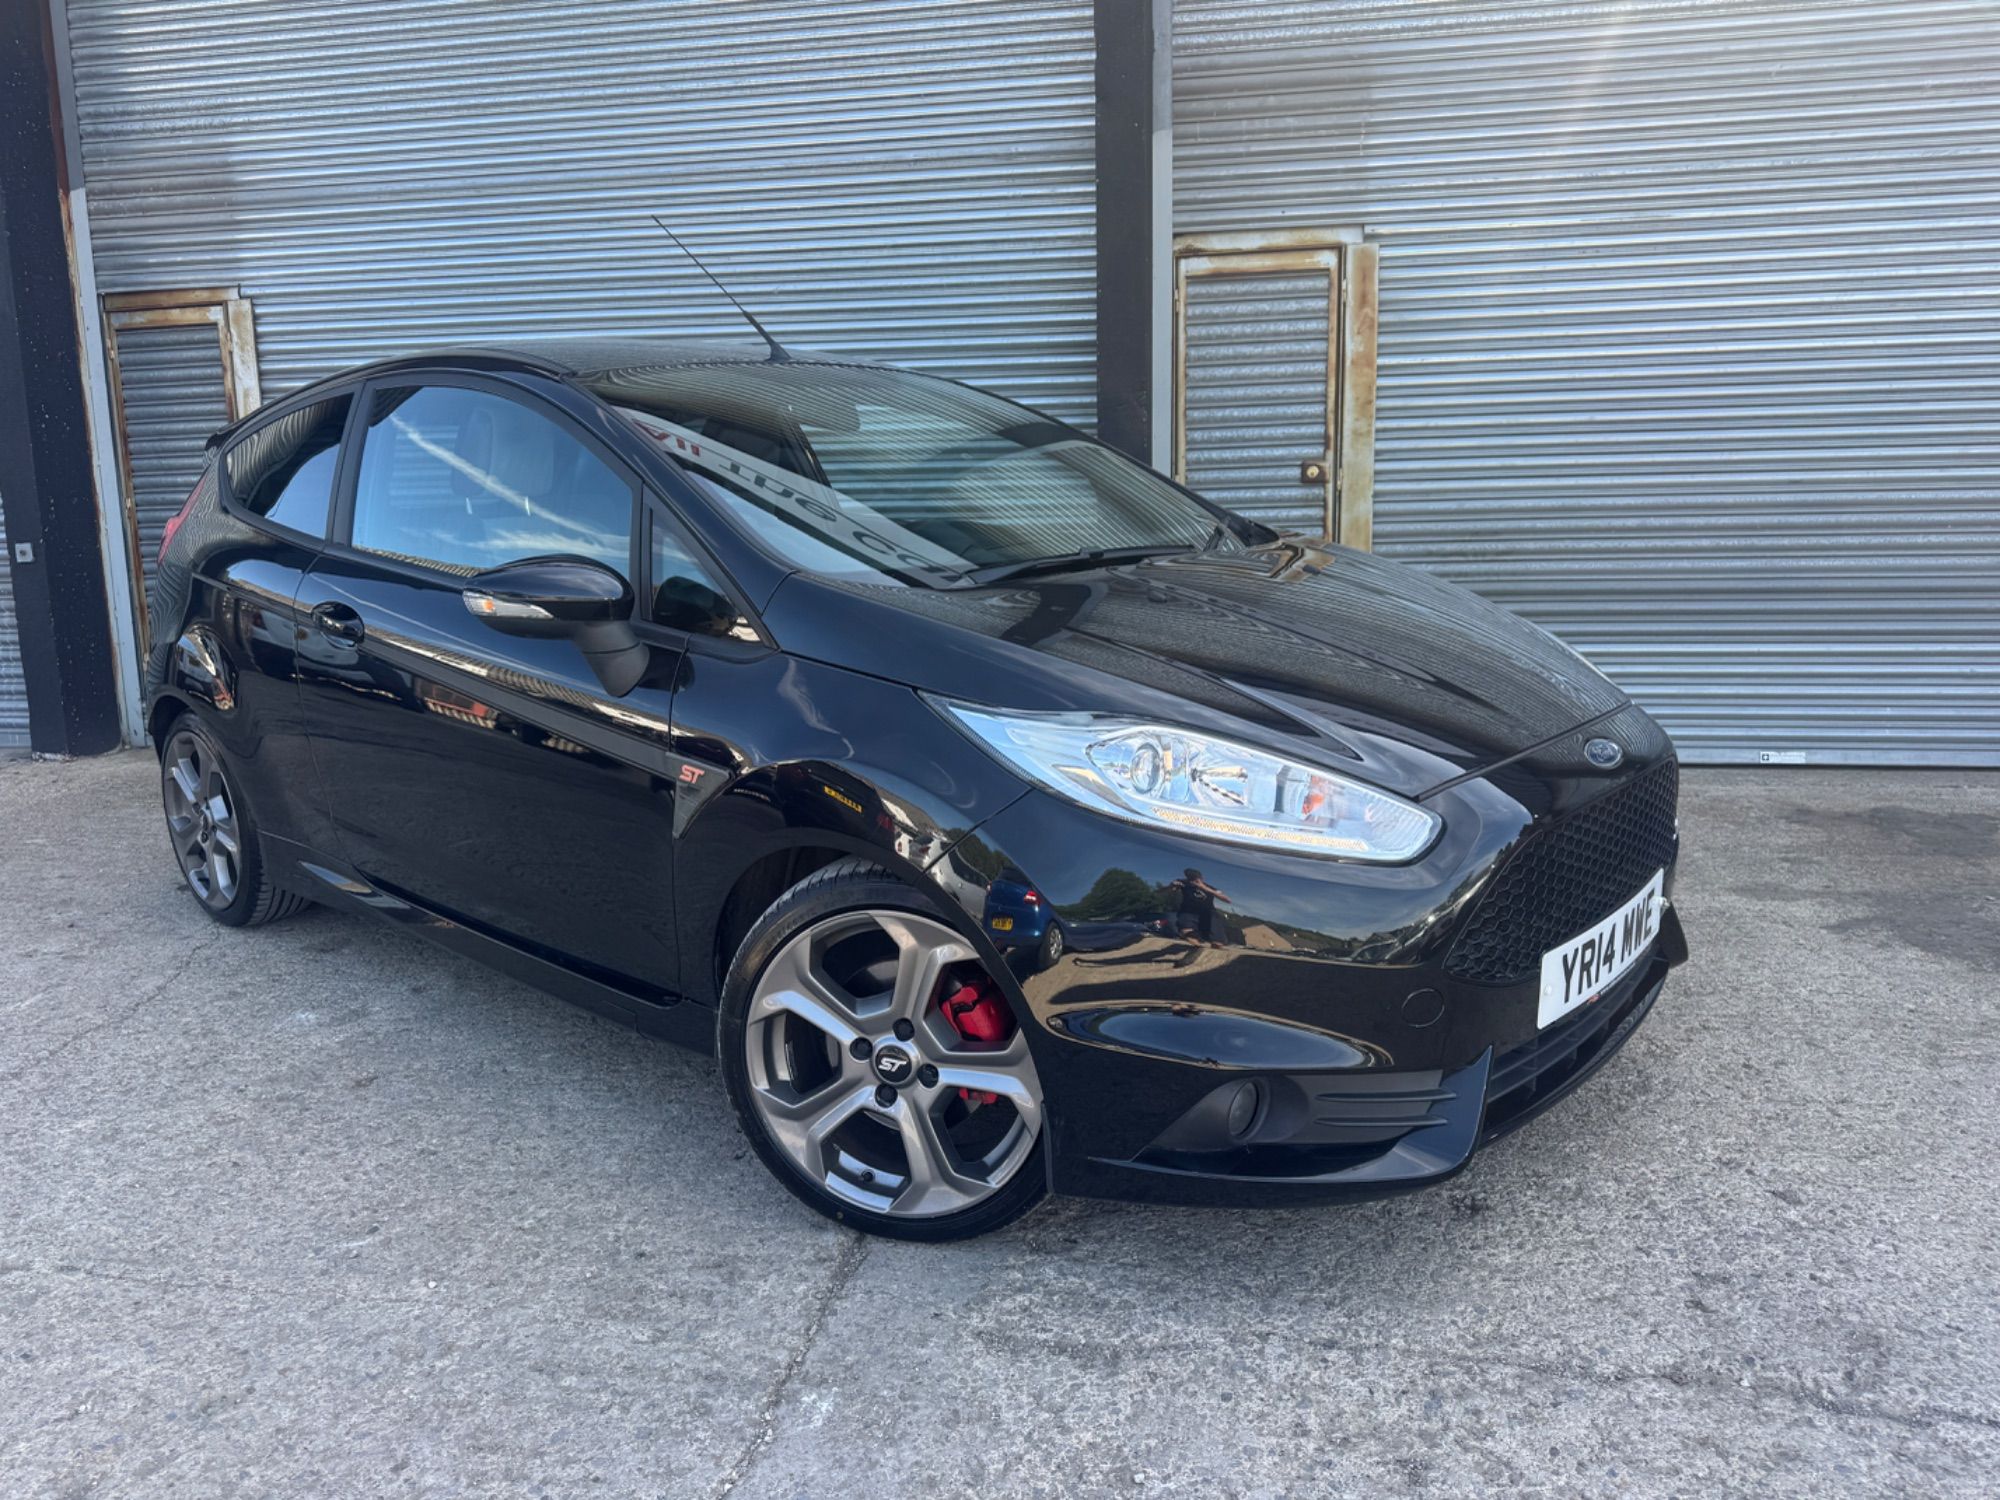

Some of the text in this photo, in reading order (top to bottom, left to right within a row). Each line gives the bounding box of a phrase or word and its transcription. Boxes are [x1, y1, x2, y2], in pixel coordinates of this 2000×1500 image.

[679, 764, 705, 784] ST
[1562, 923, 1617, 1004] YR14
[878, 1057, 907, 1072] ST
